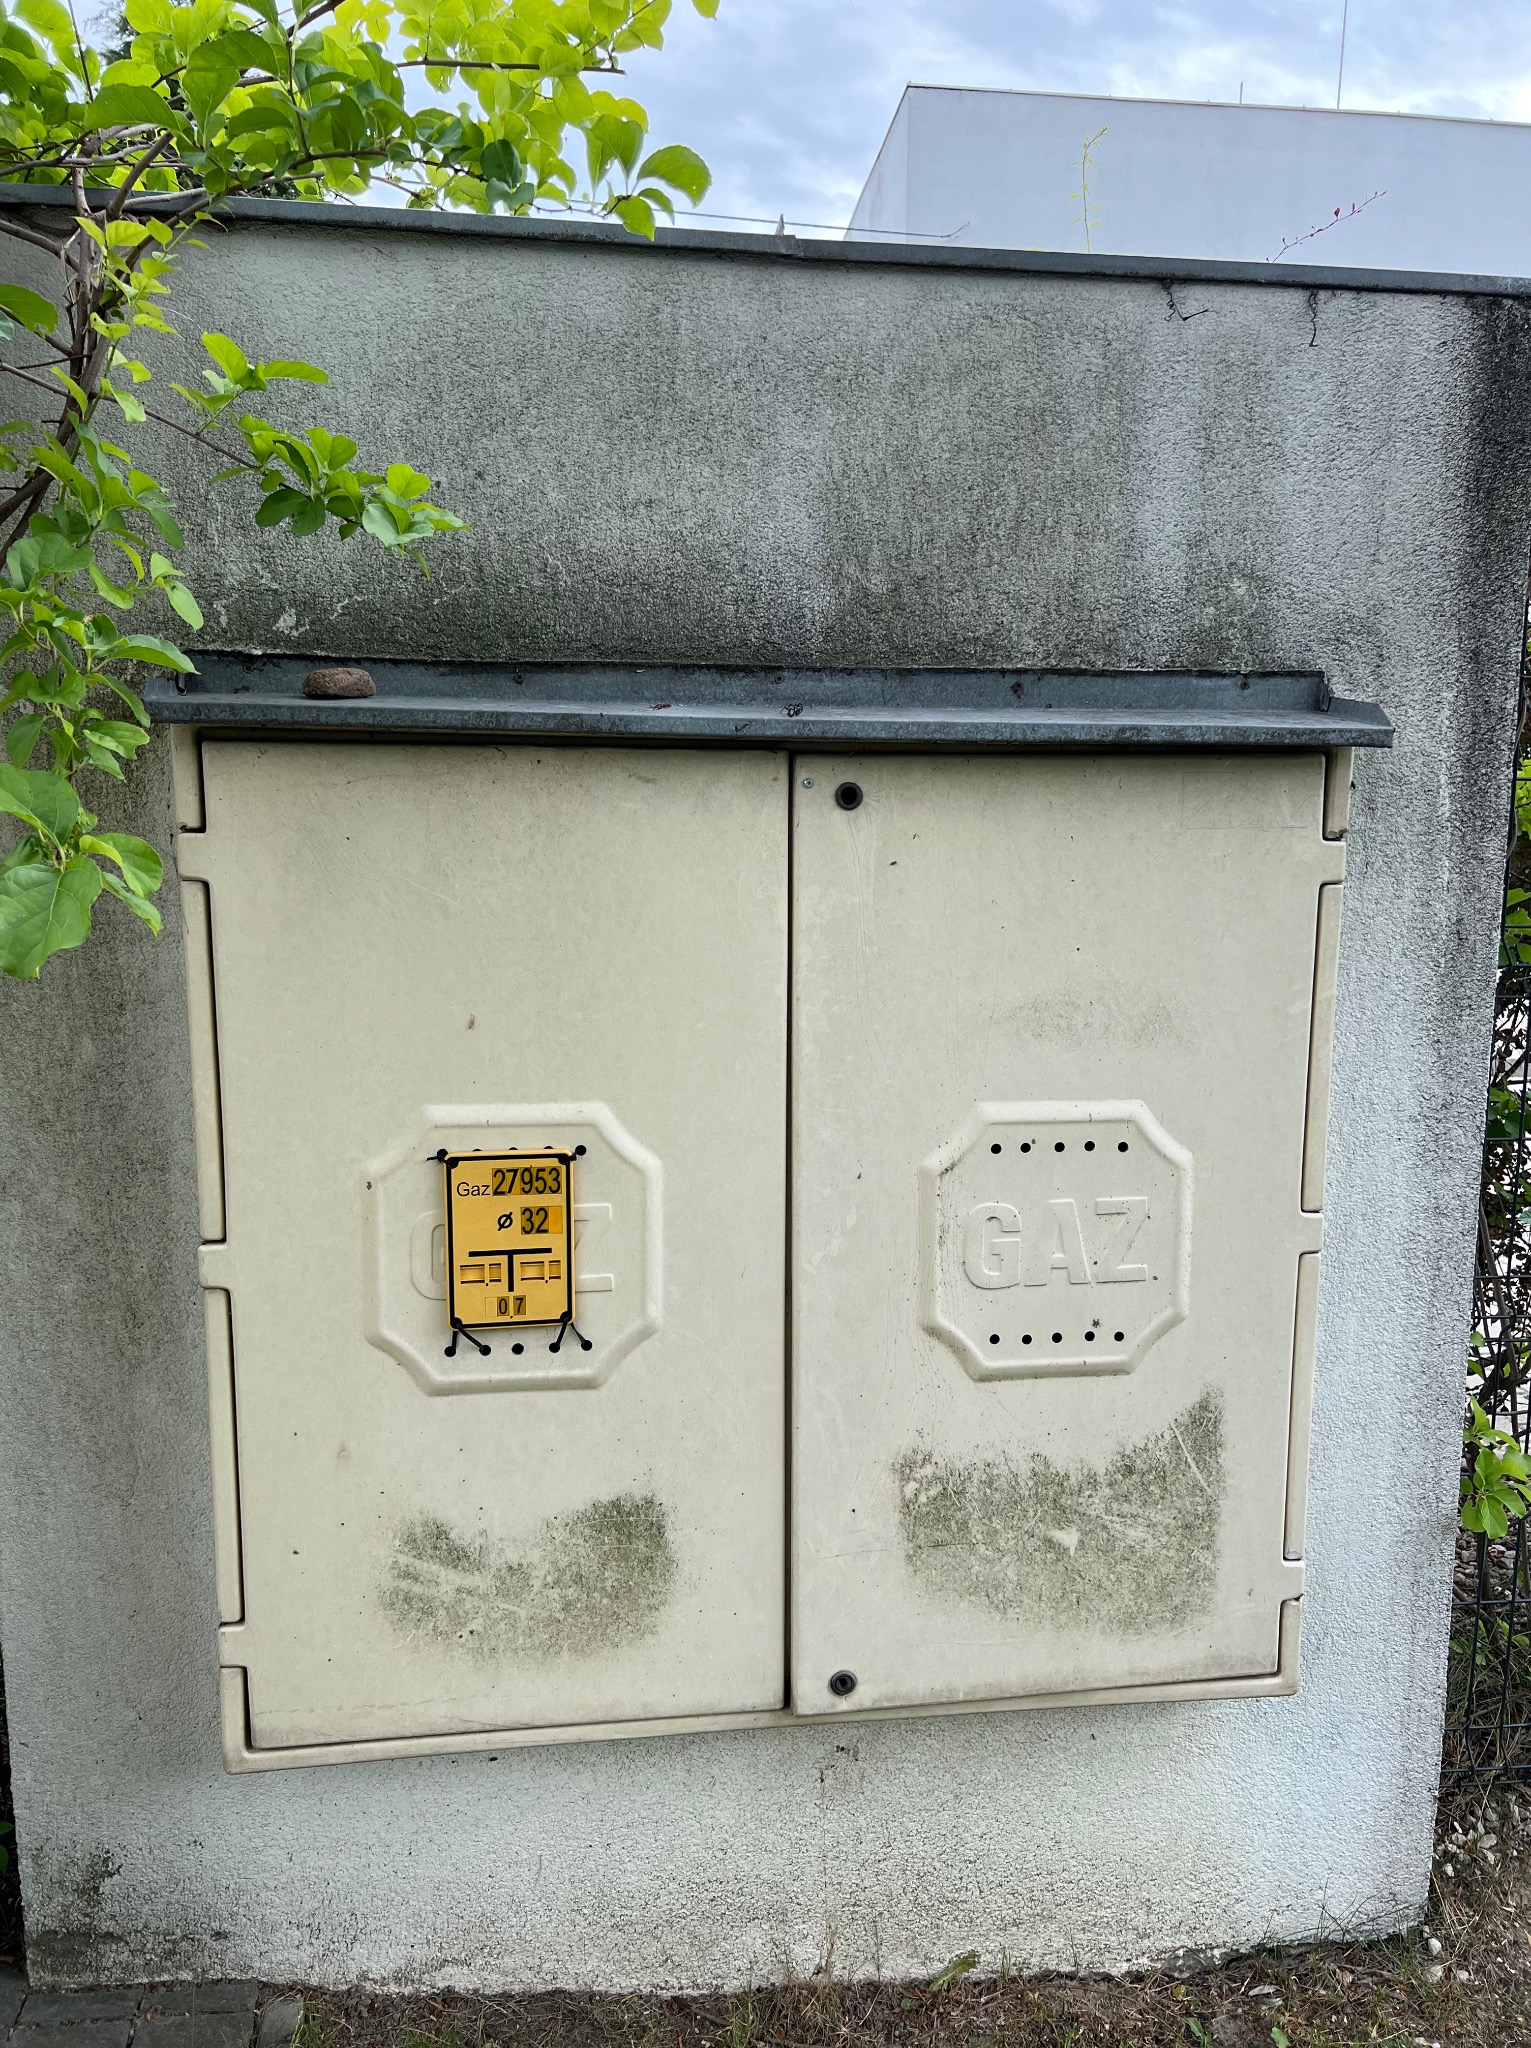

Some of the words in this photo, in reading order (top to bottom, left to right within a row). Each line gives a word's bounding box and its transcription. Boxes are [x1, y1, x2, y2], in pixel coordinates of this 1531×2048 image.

[456, 1181, 491, 1197] Gaz
[493, 1167, 561, 1195] 27953
[410, 1202, 615, 1302] GZ
[521, 1207, 548, 1235] 32
[962, 1195, 1149, 1290] GAZ
